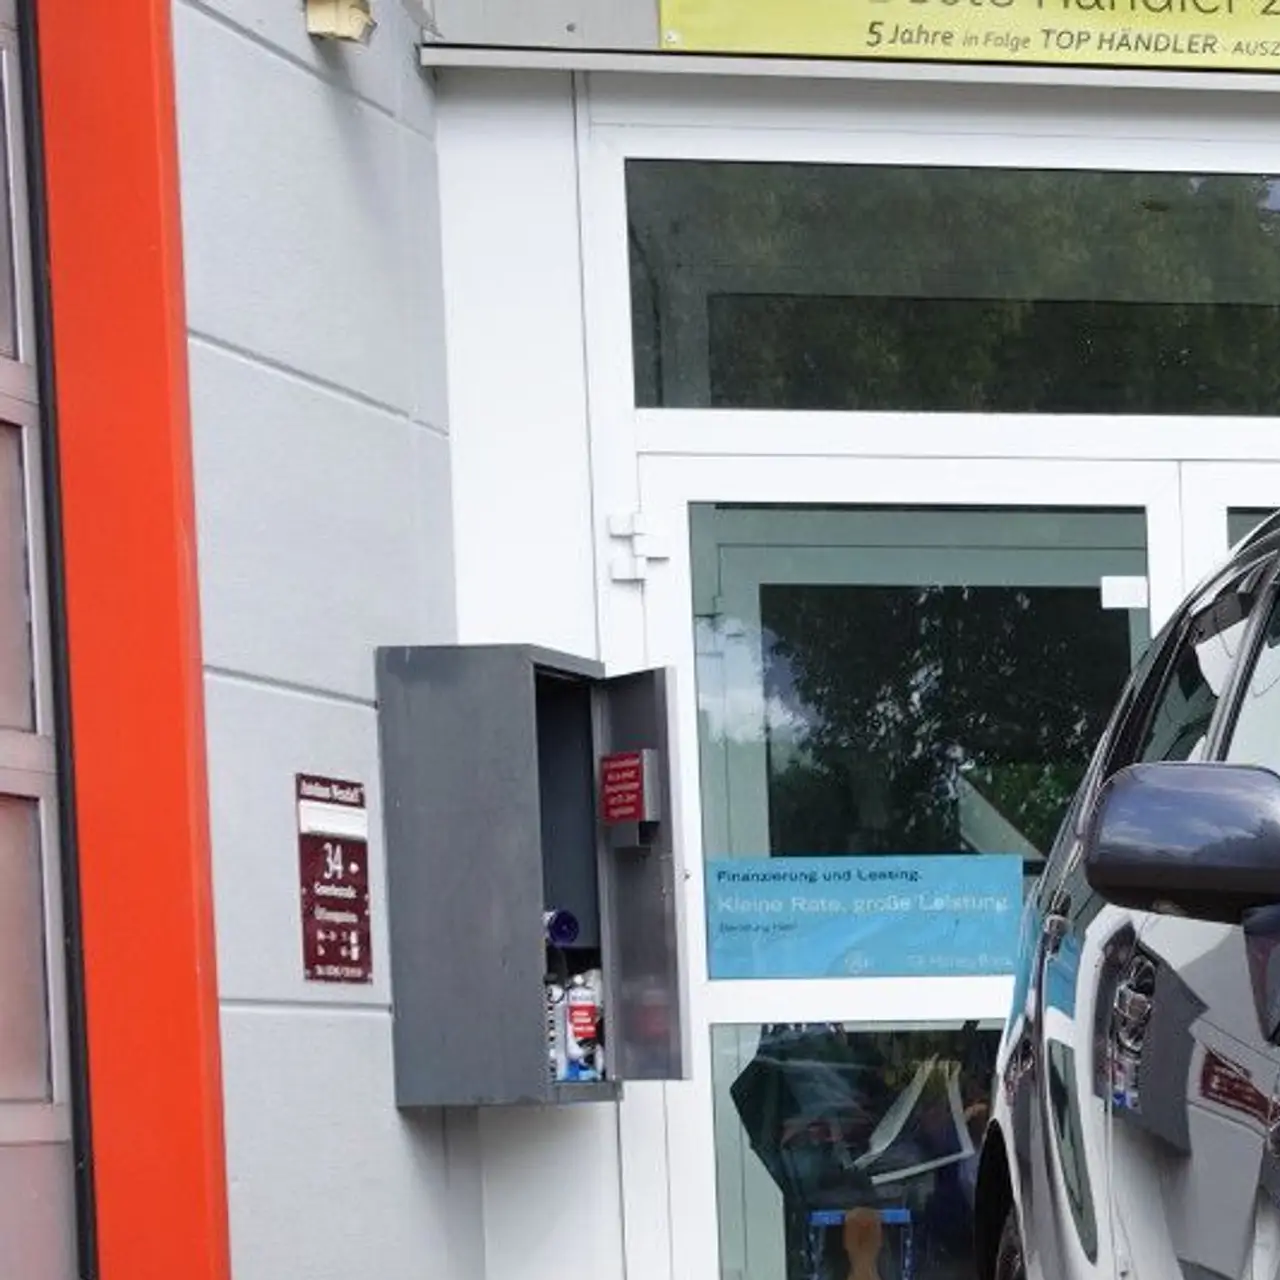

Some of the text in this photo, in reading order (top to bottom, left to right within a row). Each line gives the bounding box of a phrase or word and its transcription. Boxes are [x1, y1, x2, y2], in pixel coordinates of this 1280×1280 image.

[865, 20, 885, 48] 5
[888, 23, 955, 47] Jahre
[962, 31, 979, 47] in
[982, 31, 1031, 51] Folge
[1041, 28, 1091, 50] TOP
[1096, 28, 1219, 55] HÄNDLER
[716, 870, 819, 883] Finanzierung
[823, 870, 852, 882] und
